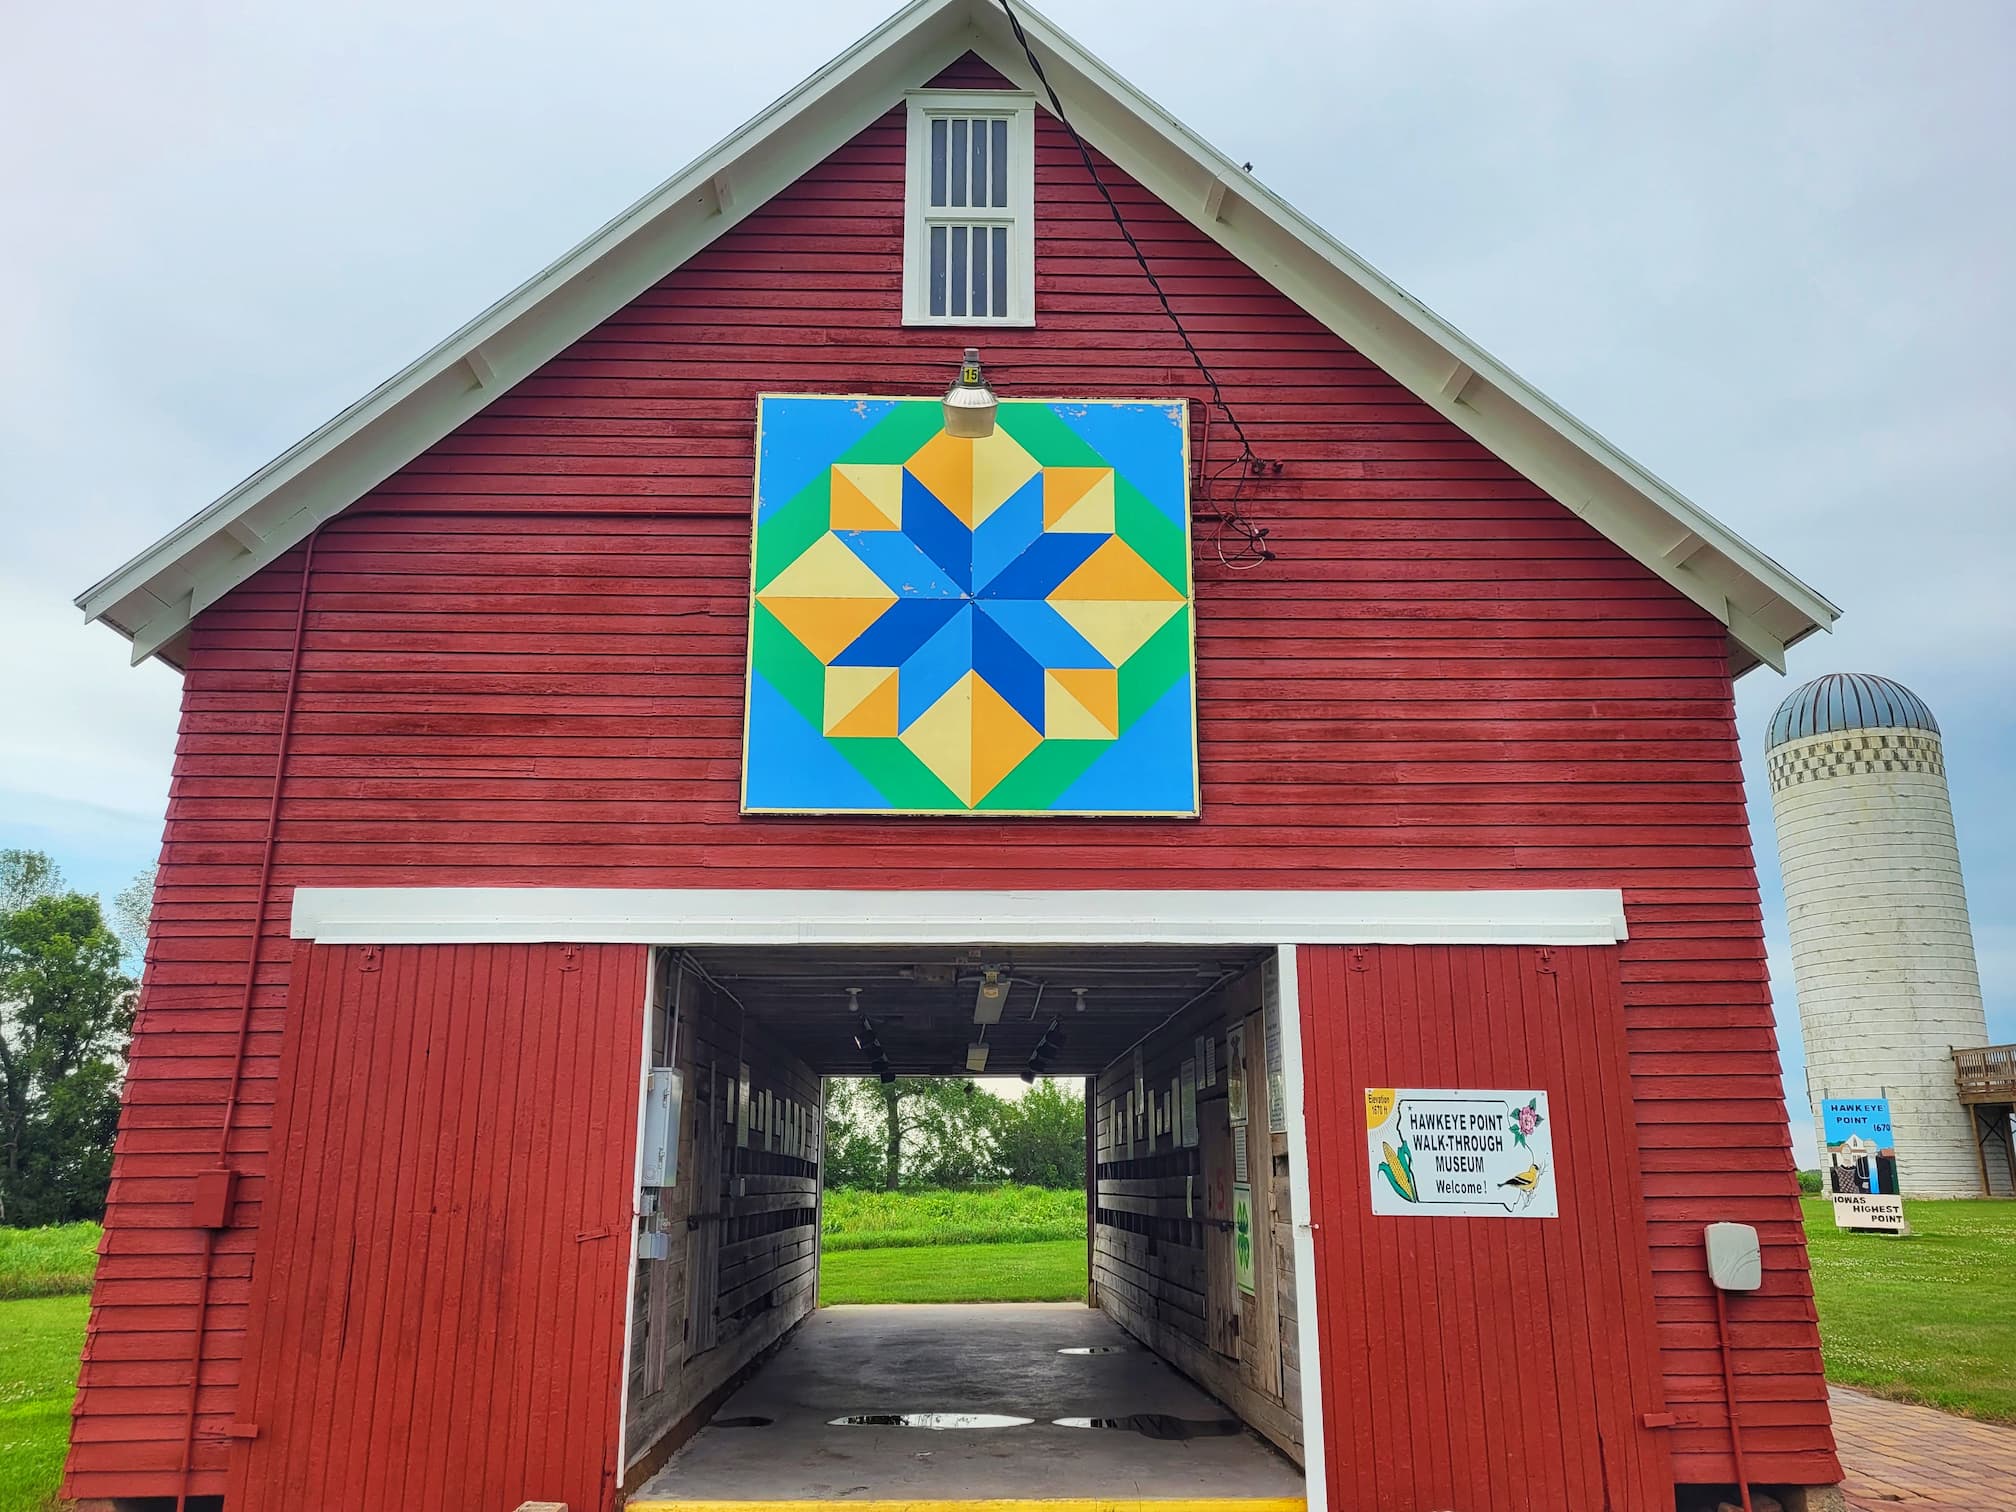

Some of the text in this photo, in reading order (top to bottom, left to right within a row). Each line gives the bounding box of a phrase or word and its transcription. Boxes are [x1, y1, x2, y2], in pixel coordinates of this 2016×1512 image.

[965, 369, 978, 380] 15
[1831, 1104, 1884, 1112] HAWKEYE
[1410, 1113, 1503, 1131] HAWKEYE POINT
[1873, 1123, 1891, 1132] 1670
[1412, 1134, 1504, 1152] WALK-THROUGH
[1435, 1155, 1485, 1173] MUSEUM
[1834, 1196, 1866, 1204] IOWAS
[1853, 1205, 1900, 1213] HIGHEST
[1871, 1215, 1903, 1223] POINT
